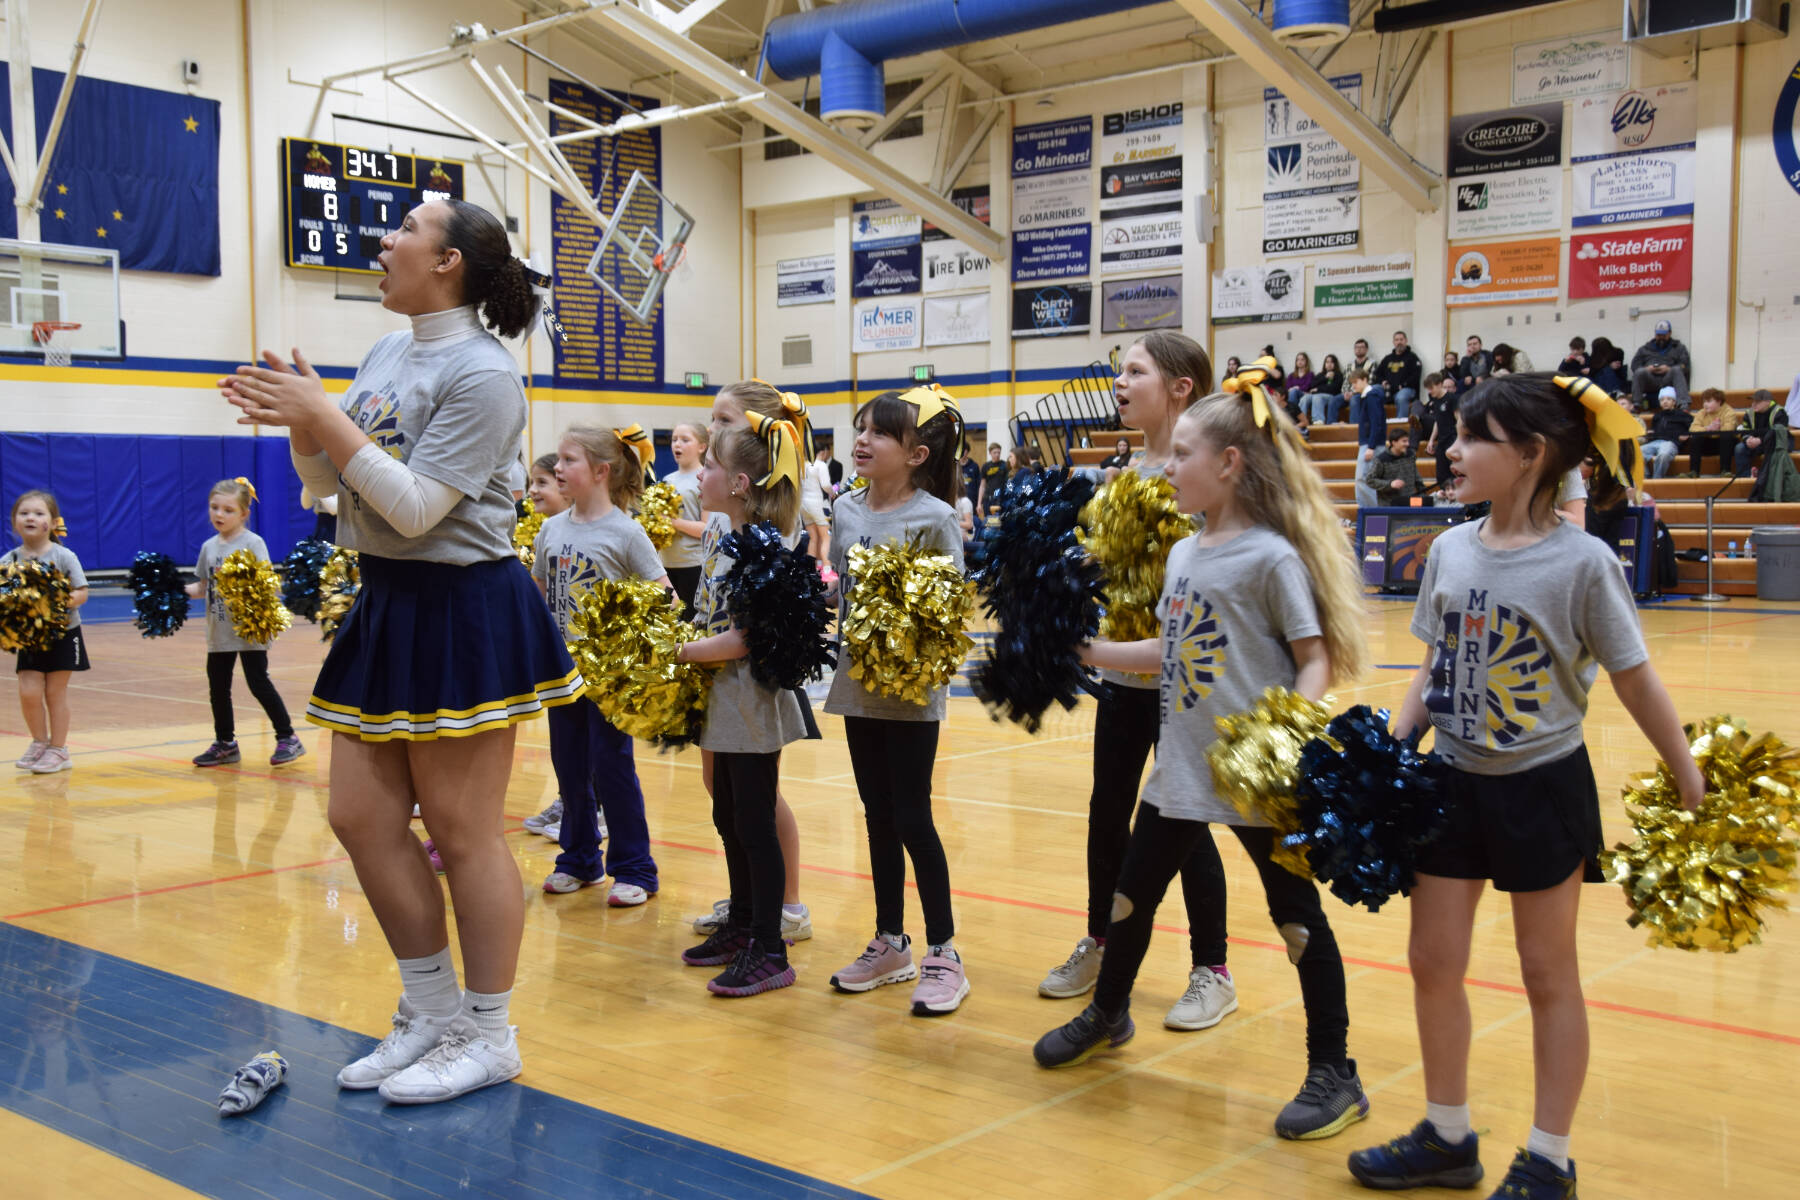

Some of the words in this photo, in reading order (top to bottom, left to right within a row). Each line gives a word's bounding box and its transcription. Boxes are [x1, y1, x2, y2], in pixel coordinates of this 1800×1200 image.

[1538, 76, 1552, 92] Go
[1554, 68, 1602, 87] Mariners!
[1102, 102, 1183, 136] BISHOP
[1611, 96, 1658, 133] Elks
[1029, 130, 1054, 141] Western
[1468, 121, 1539, 142] GREGOIRE
[1306, 138, 1338, 153] South
[1474, 135, 1533, 148] CONSTRUCTION
[348, 149, 398, 180] 34.7
[1014, 157, 1032, 171] Go
[1034, 148, 1090, 169] Mariners!
[1595, 156, 1668, 178] Lakeshore
[1124, 174, 1140, 183] BAY
[1141, 168, 1182, 181] WELDING
[1306, 165, 1351, 181] Hospital
[303, 173, 337, 192] HOMER
[1608, 181, 1655, 196] 235-8505
[367, 189, 394, 202] PERIOD
[323, 192, 339, 221] 8
[380, 203, 388, 222] 1
[1018, 213, 1032, 224] GO
[1034, 207, 1086, 223] MARINERS!
[1601, 214, 1615, 224] GO
[1615, 208, 1664, 223] MARINERS!
[299, 218, 325, 232] FOULS
[308, 229, 322, 252] 0
[1030, 229, 1055, 241] Welding
[1054, 226, 1088, 238] Fabricators
[335, 232, 349, 255] 5
[1265, 240, 1285, 252] GO
[1286, 233, 1356, 250] MARINERS!
[926, 254, 955, 279] TIRE
[955, 250, 991, 276] TOWN
[1016, 269, 1037, 279] Show
[1037, 265, 1066, 277] Mariner
[1066, 263, 1088, 275] Pride!
[1356, 263, 1386, 274] Builders
[1386, 260, 1411, 273] Supply
[1598, 264, 1627, 276] Mike
[1628, 260, 1663, 274] Barth
[1598, 277, 1662, 291] 907-226-3600
[1031, 298, 1073, 311] NORTH
[1035, 307, 1070, 320] WEST
[862, 323, 914, 339] PLUMBING
